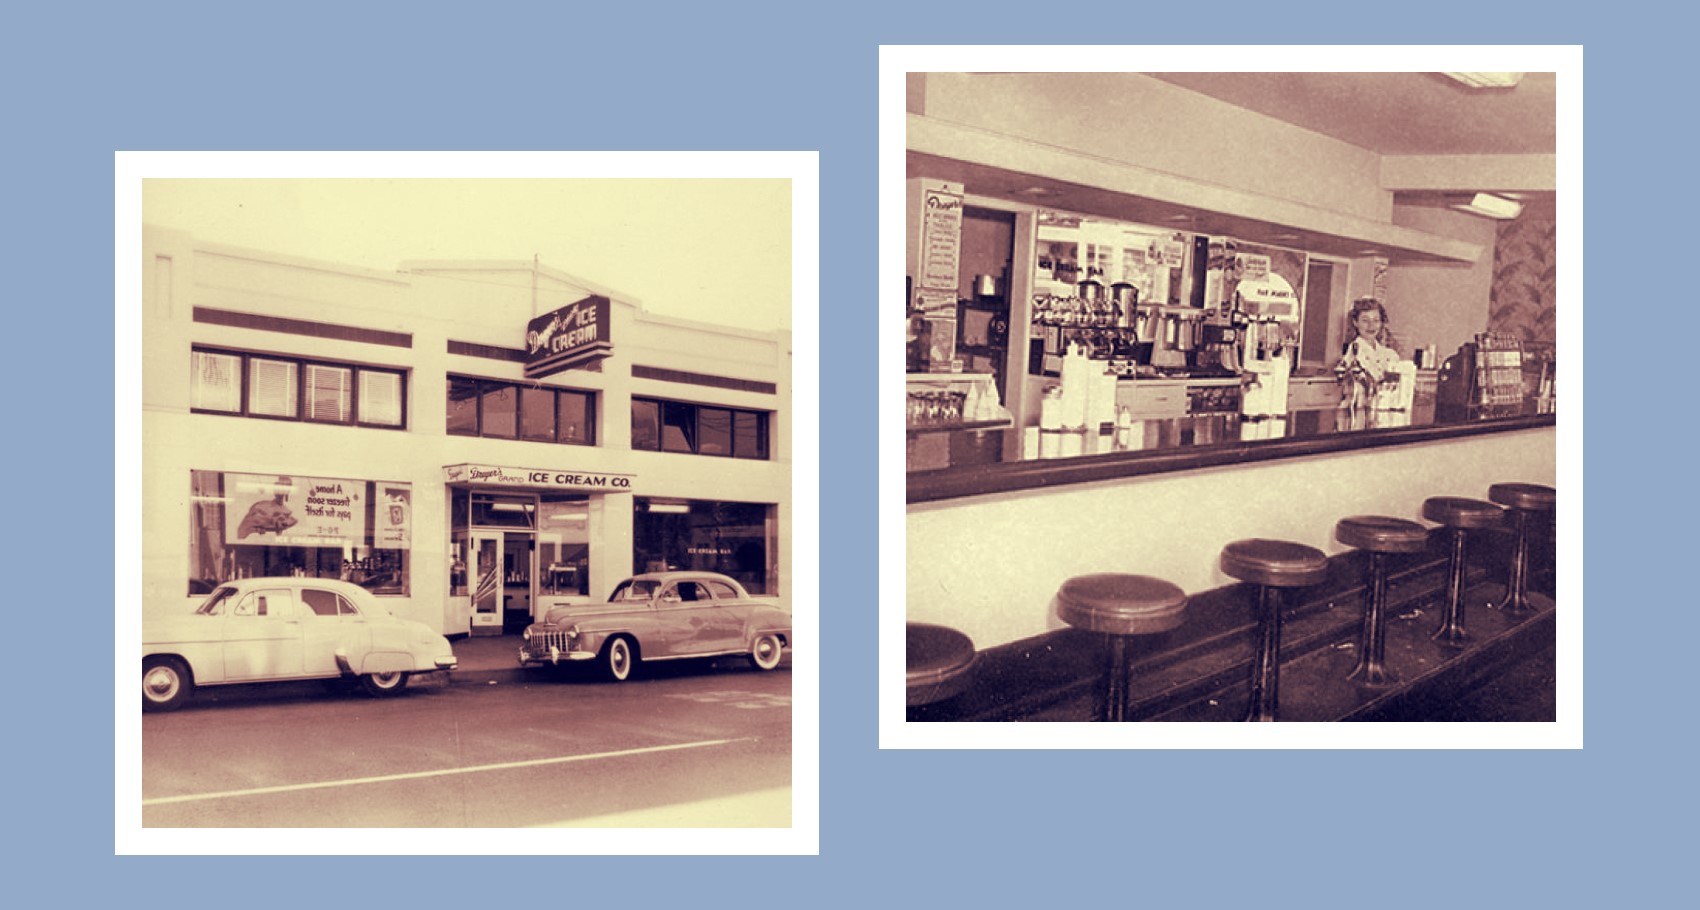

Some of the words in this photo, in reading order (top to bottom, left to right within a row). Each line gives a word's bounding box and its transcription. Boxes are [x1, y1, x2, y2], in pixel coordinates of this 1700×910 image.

[576, 304, 597, 327] ICE
[551, 323, 597, 353] CREAM
[469, 466, 503, 482] Dreyer's
[528, 472, 549, 483] ICE
[555, 474, 606, 486] CREAM
[611, 477, 631, 488] CO.
